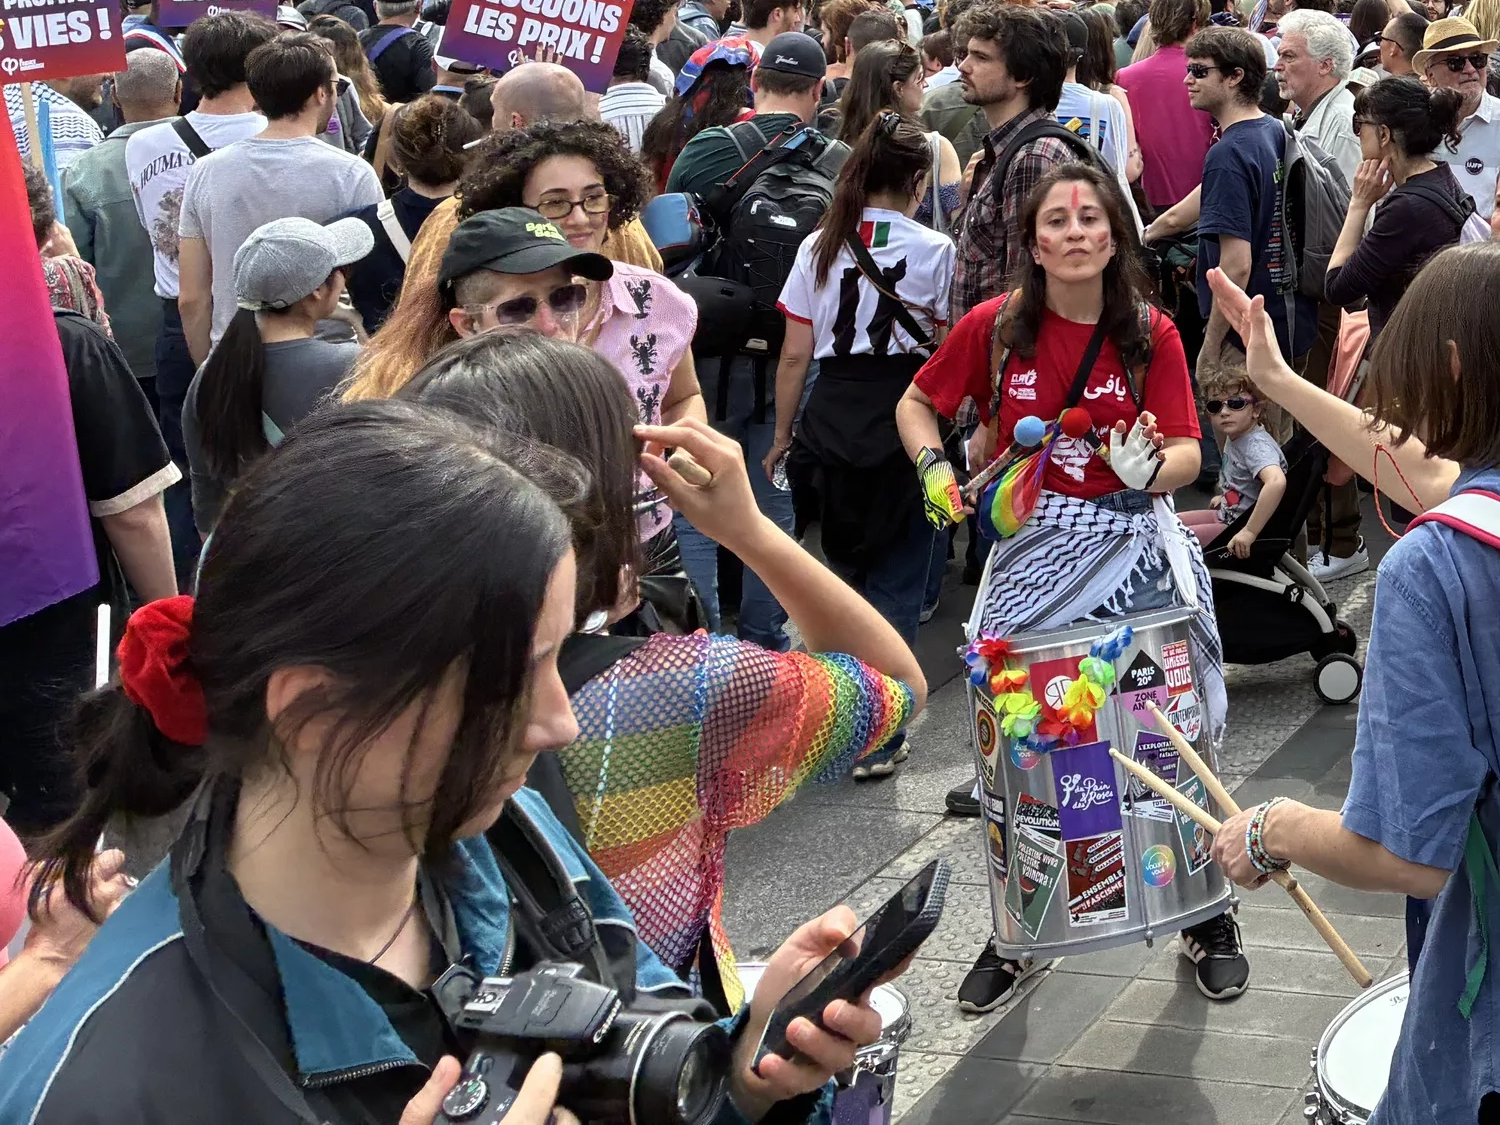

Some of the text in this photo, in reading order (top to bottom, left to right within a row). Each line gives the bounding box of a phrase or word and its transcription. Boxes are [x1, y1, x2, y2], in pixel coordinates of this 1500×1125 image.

[7, 7, 112, 50] VIES !
[463, 4, 607, 64] LES PRIX !
[1131, 665, 1155, 679] PARIS
[1134, 690, 1157, 702] ZONE
[1138, 740, 1173, 751] L'EXPLOITAT
[1083, 777, 1111, 793] Pain
[1084, 789, 1114, 810] Roses
[1081, 870, 1125, 899] ENSEMBLE
[1086, 881, 1124, 910] FASCISME
[592, 998, 623, 1044] Canon
